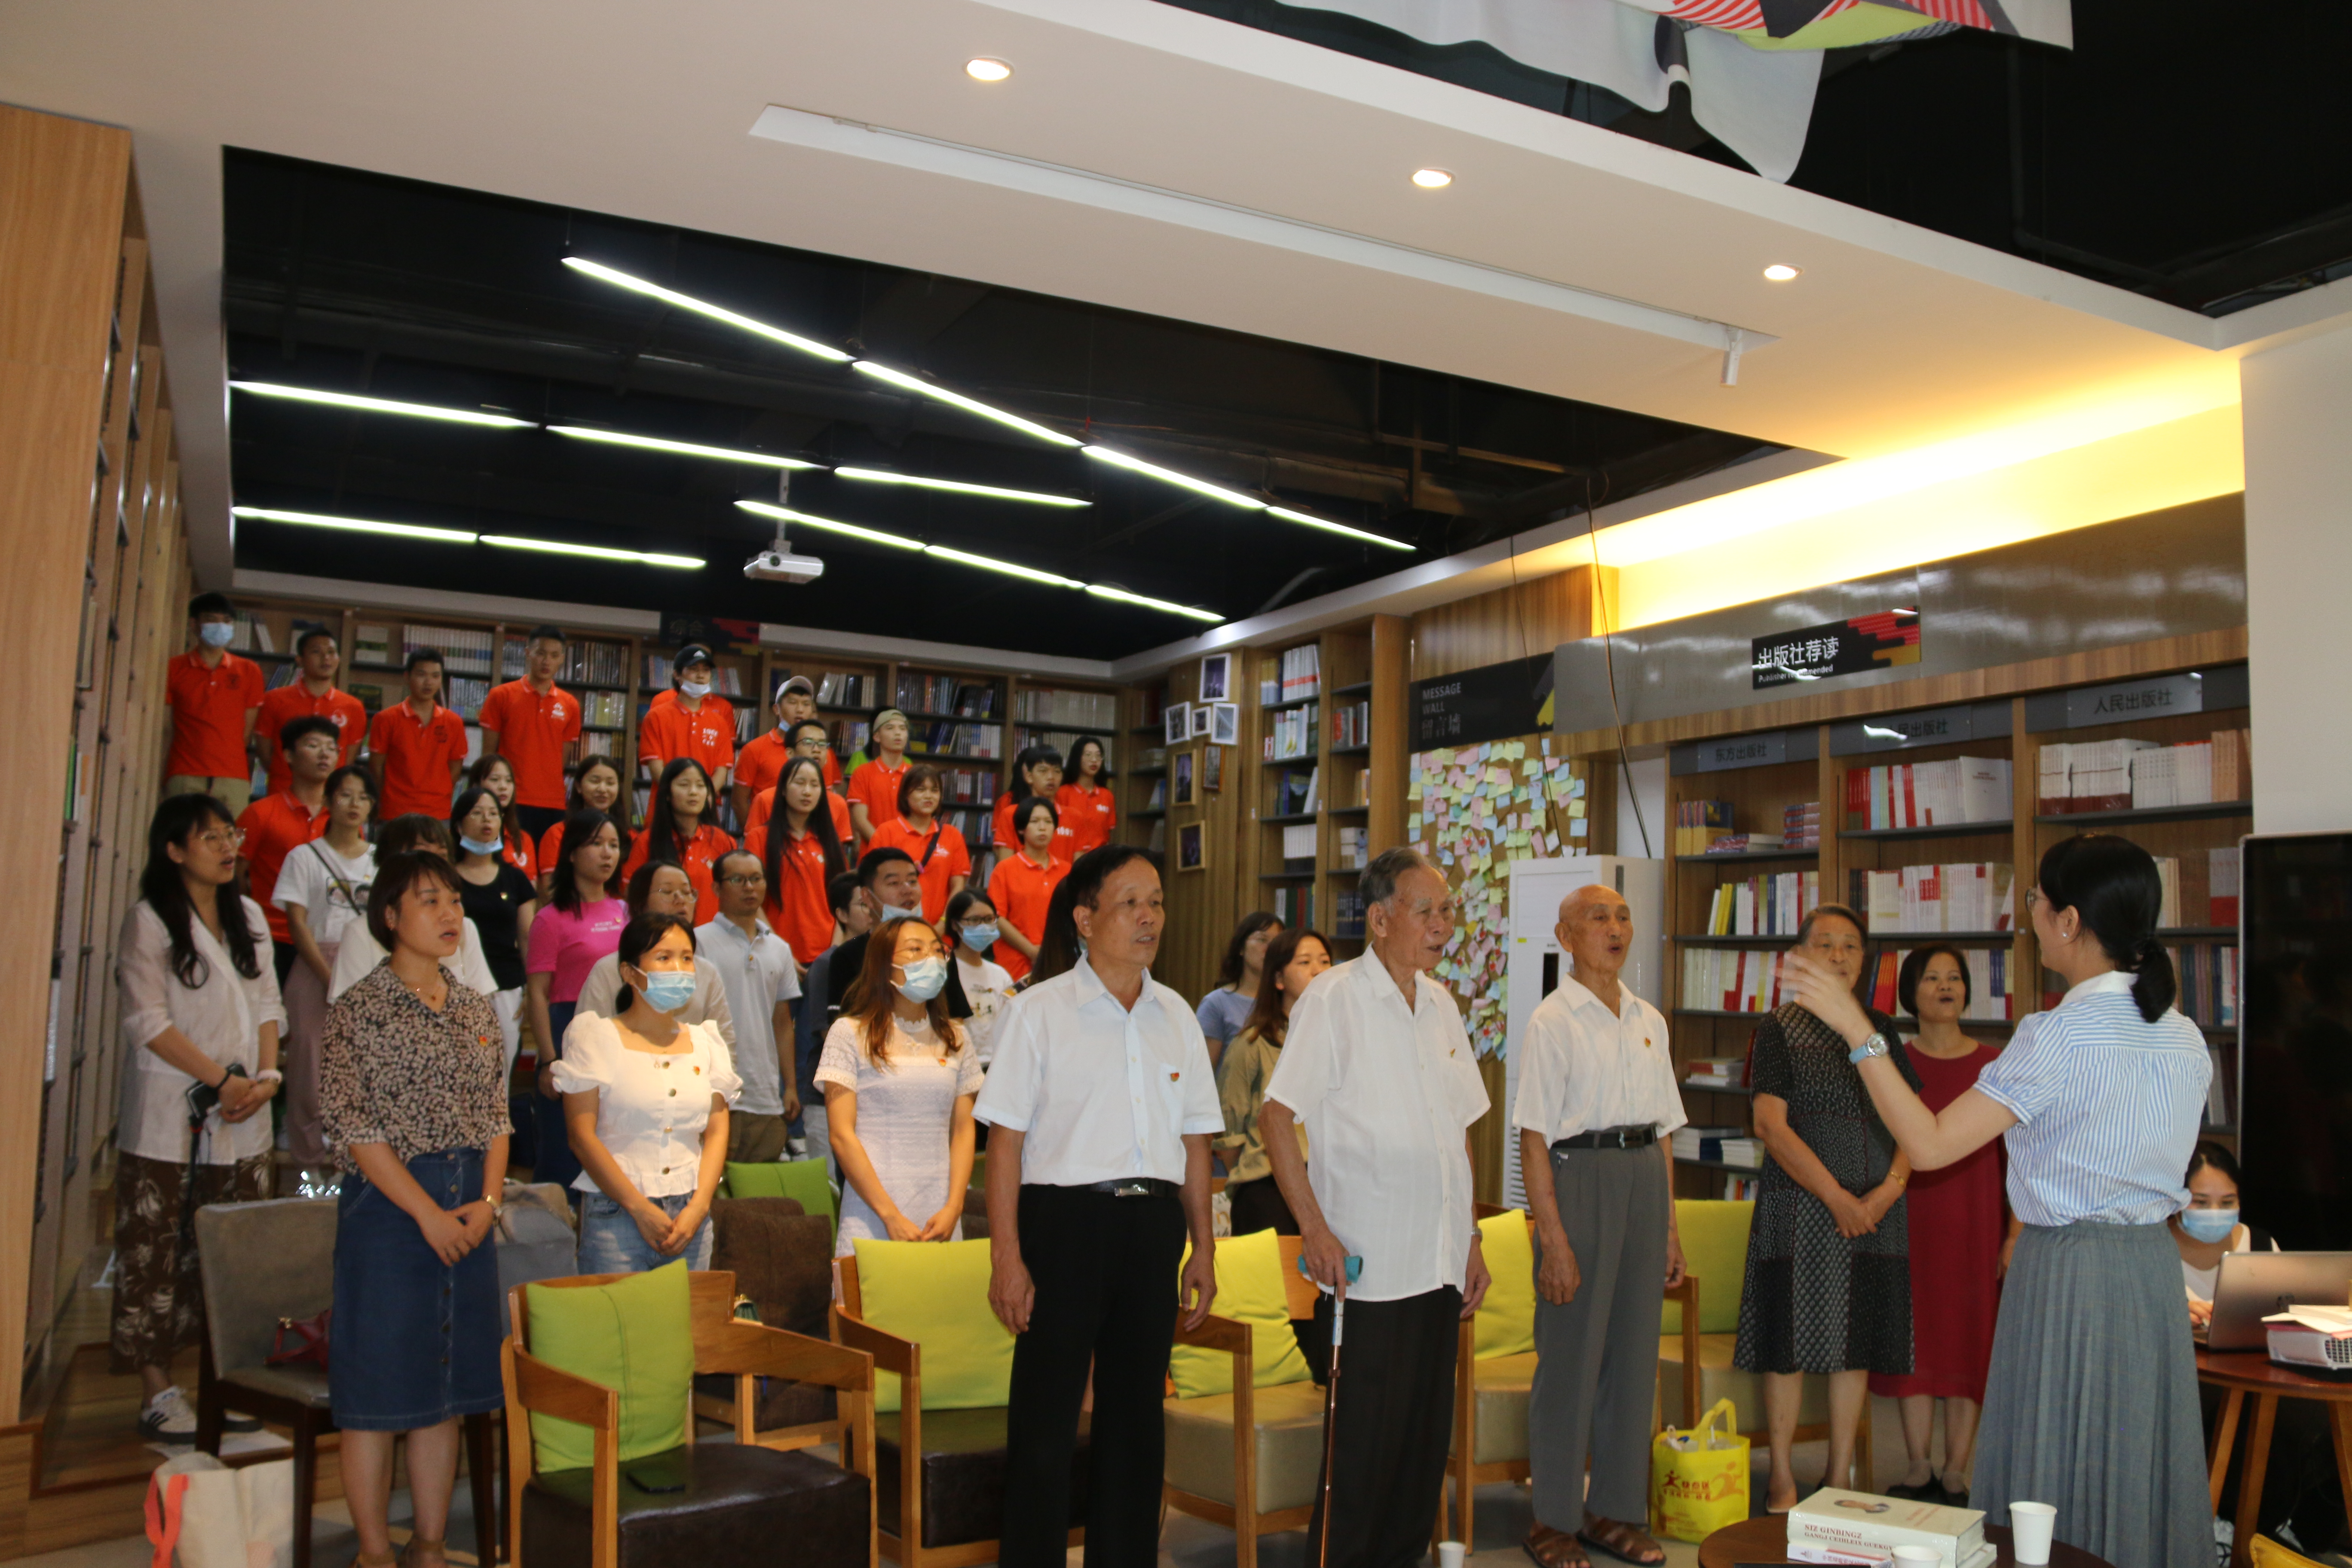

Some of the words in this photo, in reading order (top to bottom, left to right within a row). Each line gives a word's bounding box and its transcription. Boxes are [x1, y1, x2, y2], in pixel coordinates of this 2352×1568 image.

[1758, 636, 1839, 669] 出版社荐读
[1759, 673, 1786, 683] Publisher
[1423, 682, 1461, 700] MESSAGE
[1423, 701, 1445, 715] WALL
[2095, 688, 2172, 714] 人民出版社
[1804, 1532, 1828, 1540] GANGJ
[1805, 1524, 1818, 1532] SIZ
[1820, 1527, 1862, 1539] GINBINGZ
